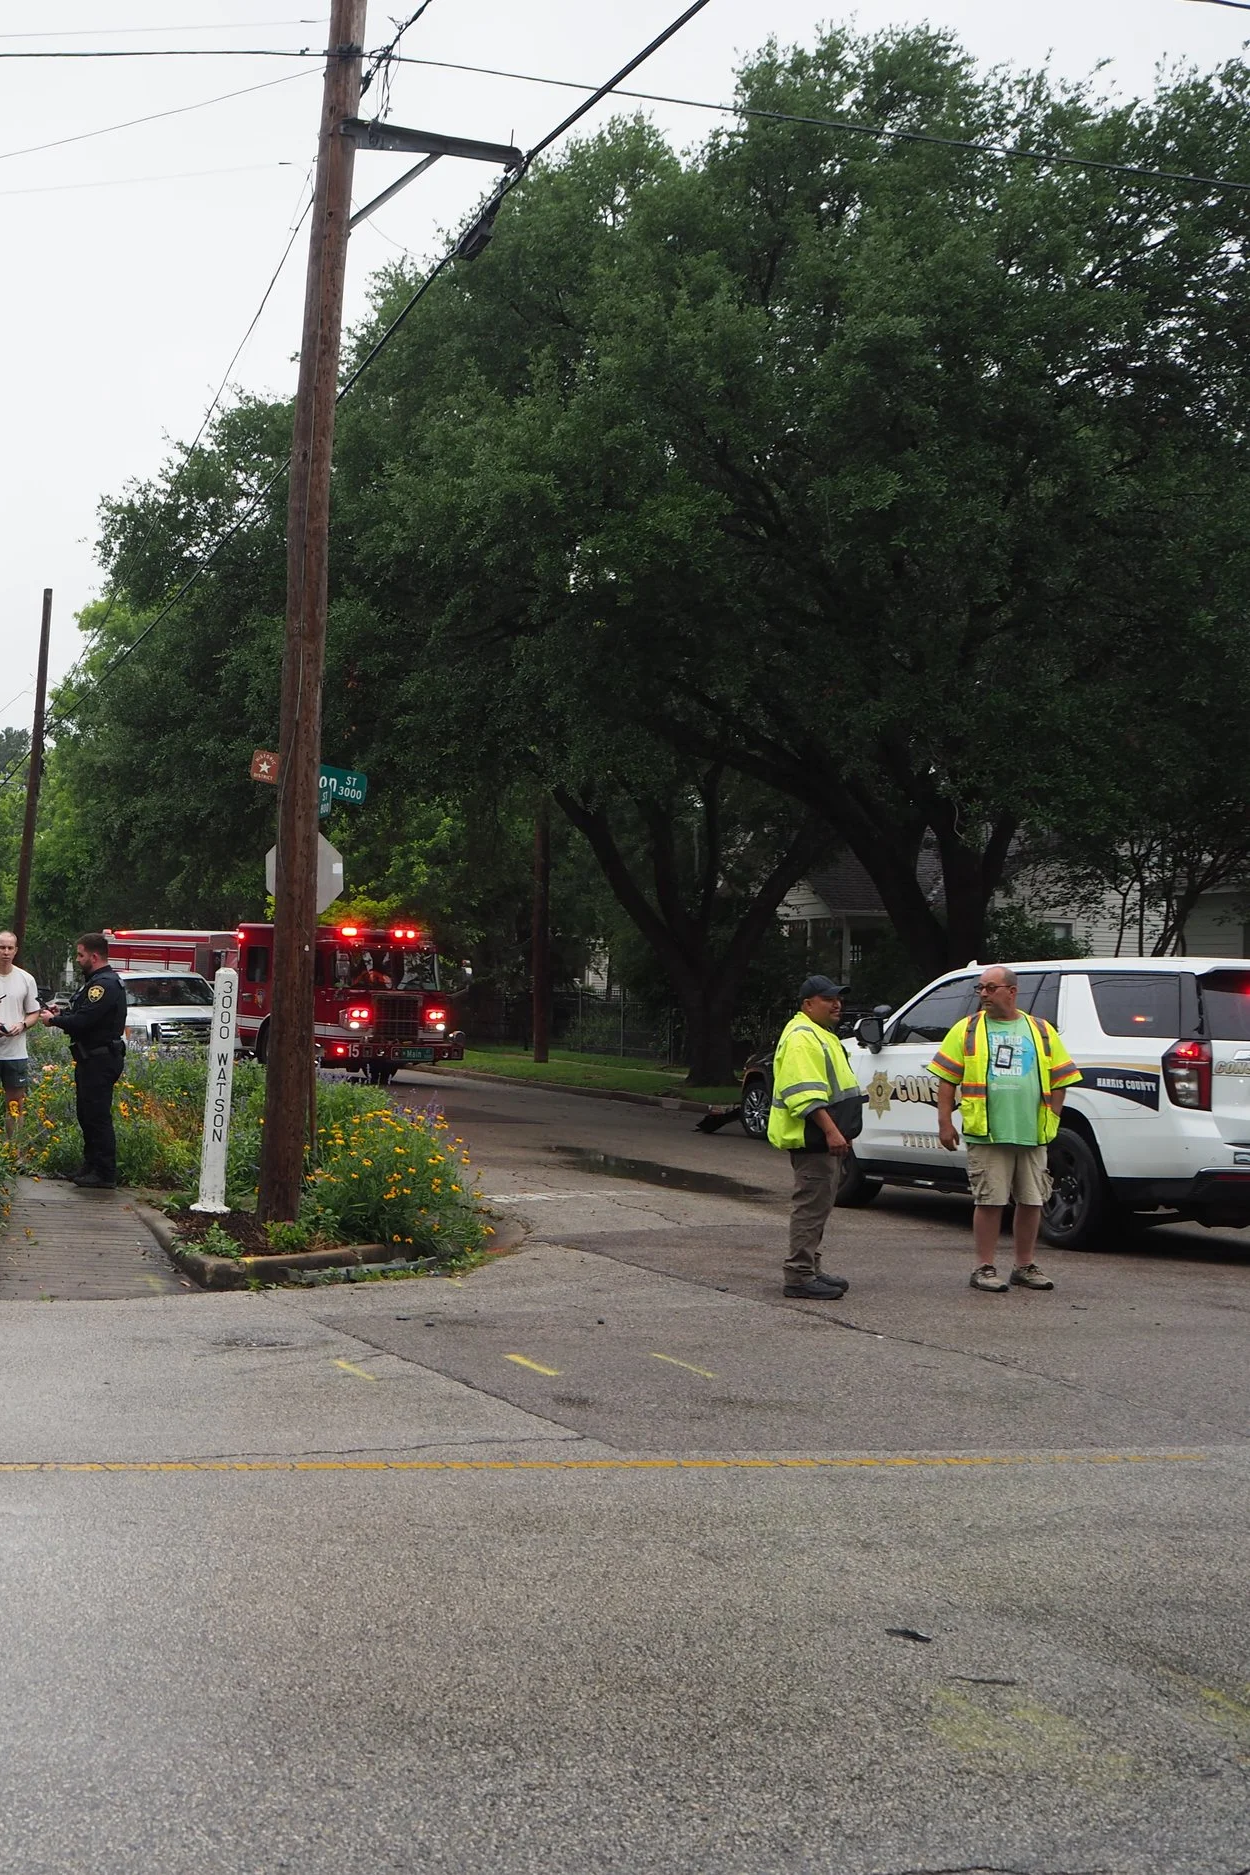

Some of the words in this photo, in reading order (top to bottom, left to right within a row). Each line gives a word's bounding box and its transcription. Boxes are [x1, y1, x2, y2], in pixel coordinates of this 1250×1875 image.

[346, 776, 357, 787] ST
[338, 786, 362, 800] 3000
[219, 980, 233, 1039] 3000
[347, 1044, 359, 1058] 15
[406, 1049, 422, 1058] Main
[1096, 1077, 1124, 1089] HARRIS
[1125, 1080, 1157, 1092] COUNTY
[212, 1053, 229, 1143] WATSON
